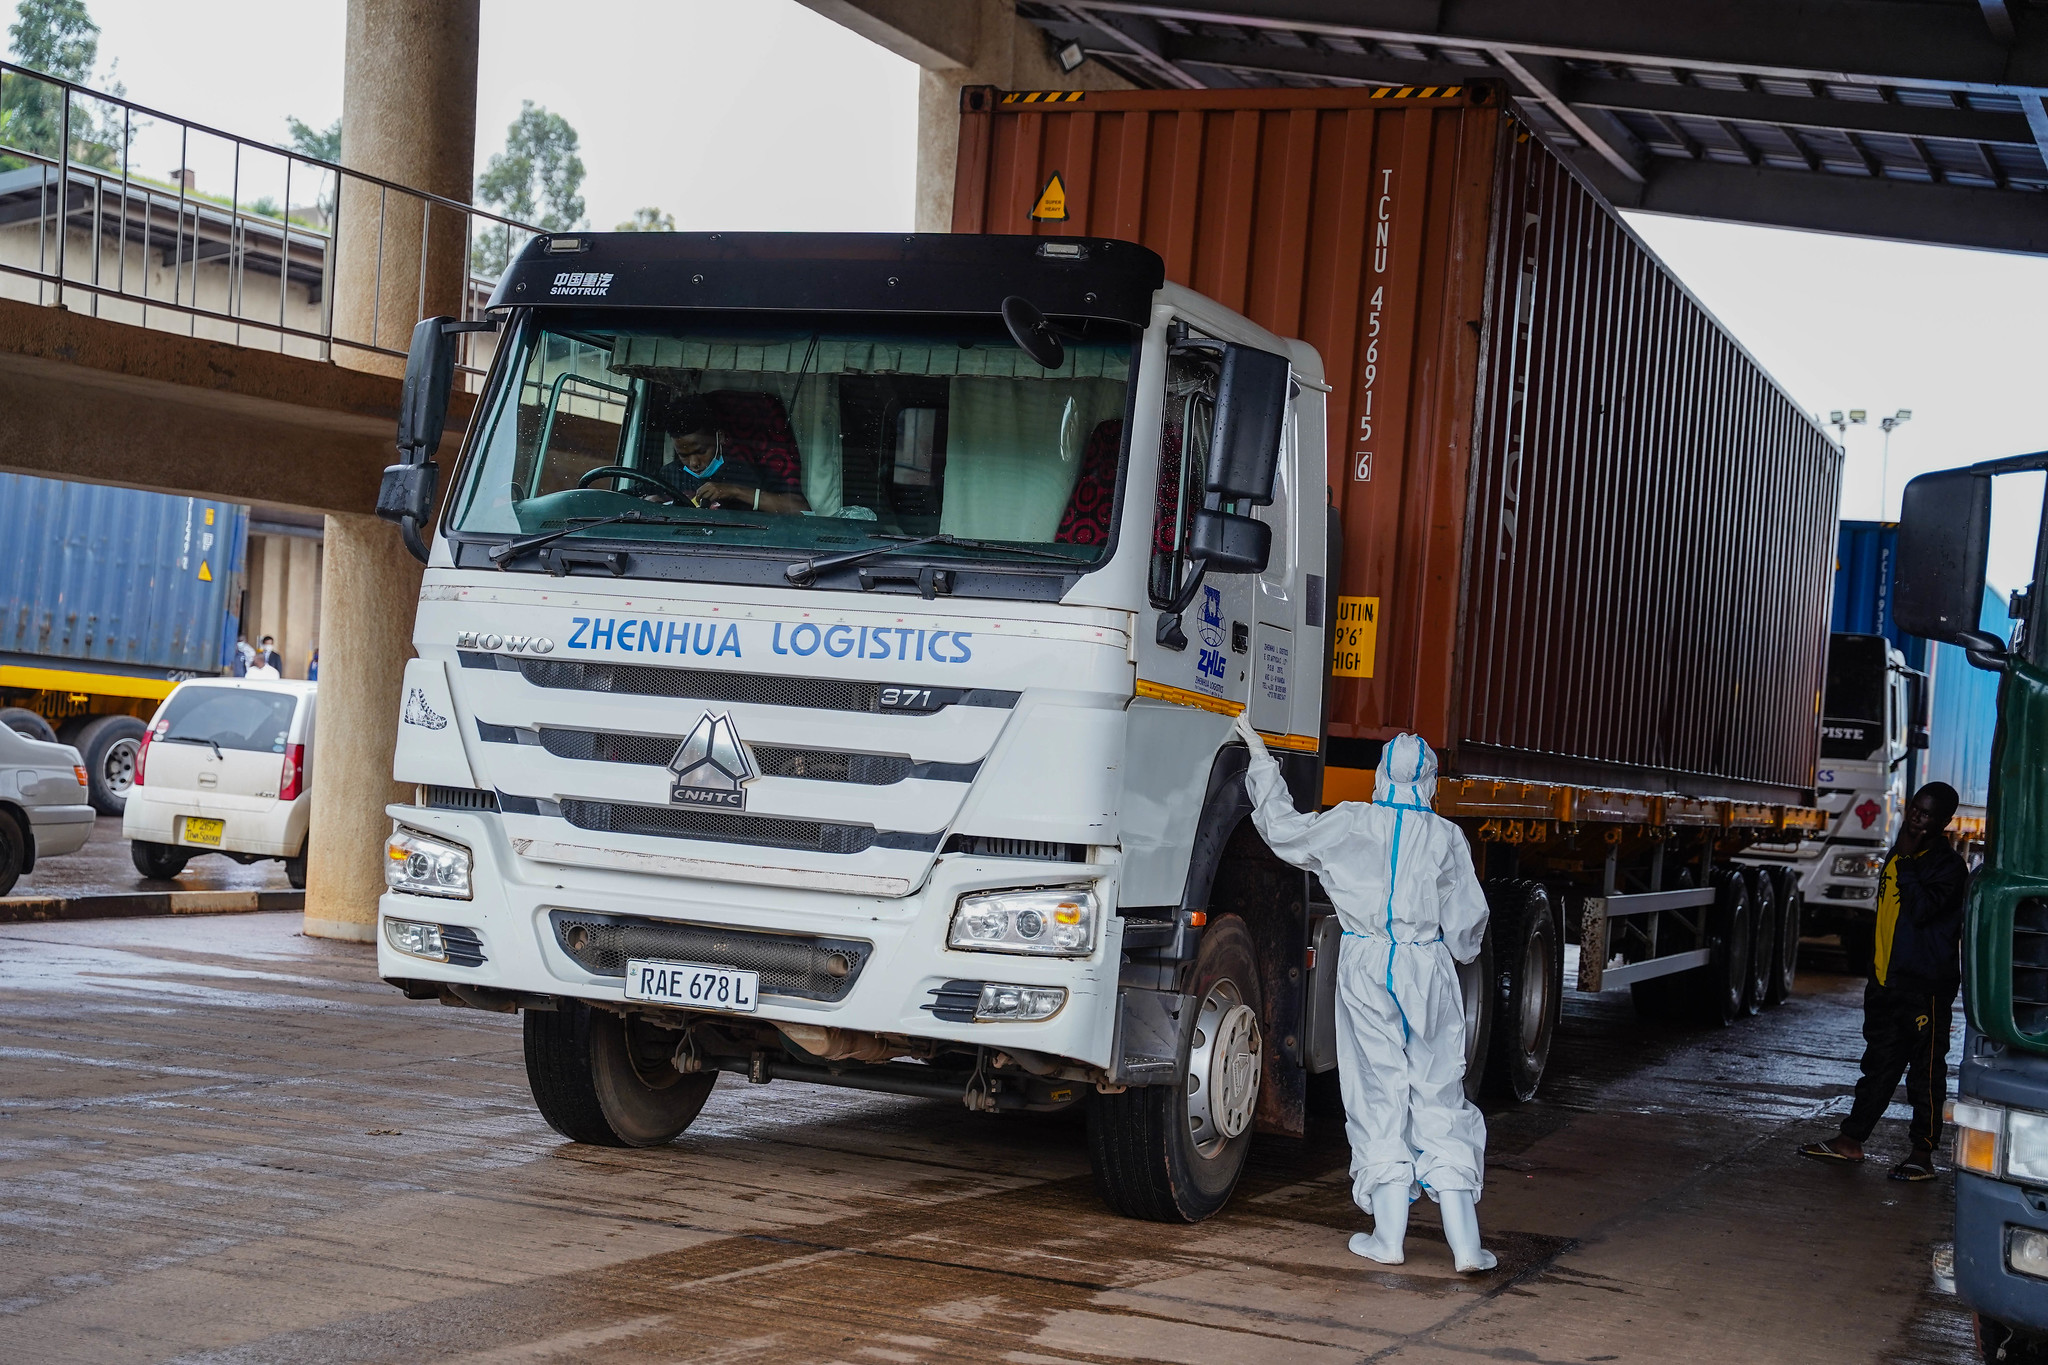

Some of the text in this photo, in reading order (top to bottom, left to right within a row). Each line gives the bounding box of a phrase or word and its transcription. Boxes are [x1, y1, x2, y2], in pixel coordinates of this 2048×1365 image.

[1374, 169, 1392, 273] TCNU
[550, 287, 608, 295] SINOTRUK
[553, 272, 614, 287] 中国重汽
[1360, 286, 1383, 441] 456915
[456, 630, 555, 654] HOWO
[567, 616, 973, 663] ZHENHUA LOGISTICS
[880, 688, 932, 707] 371
[673, 789, 740, 804] CNHTC
[640, 968, 749, 1005] RAE 678 L
